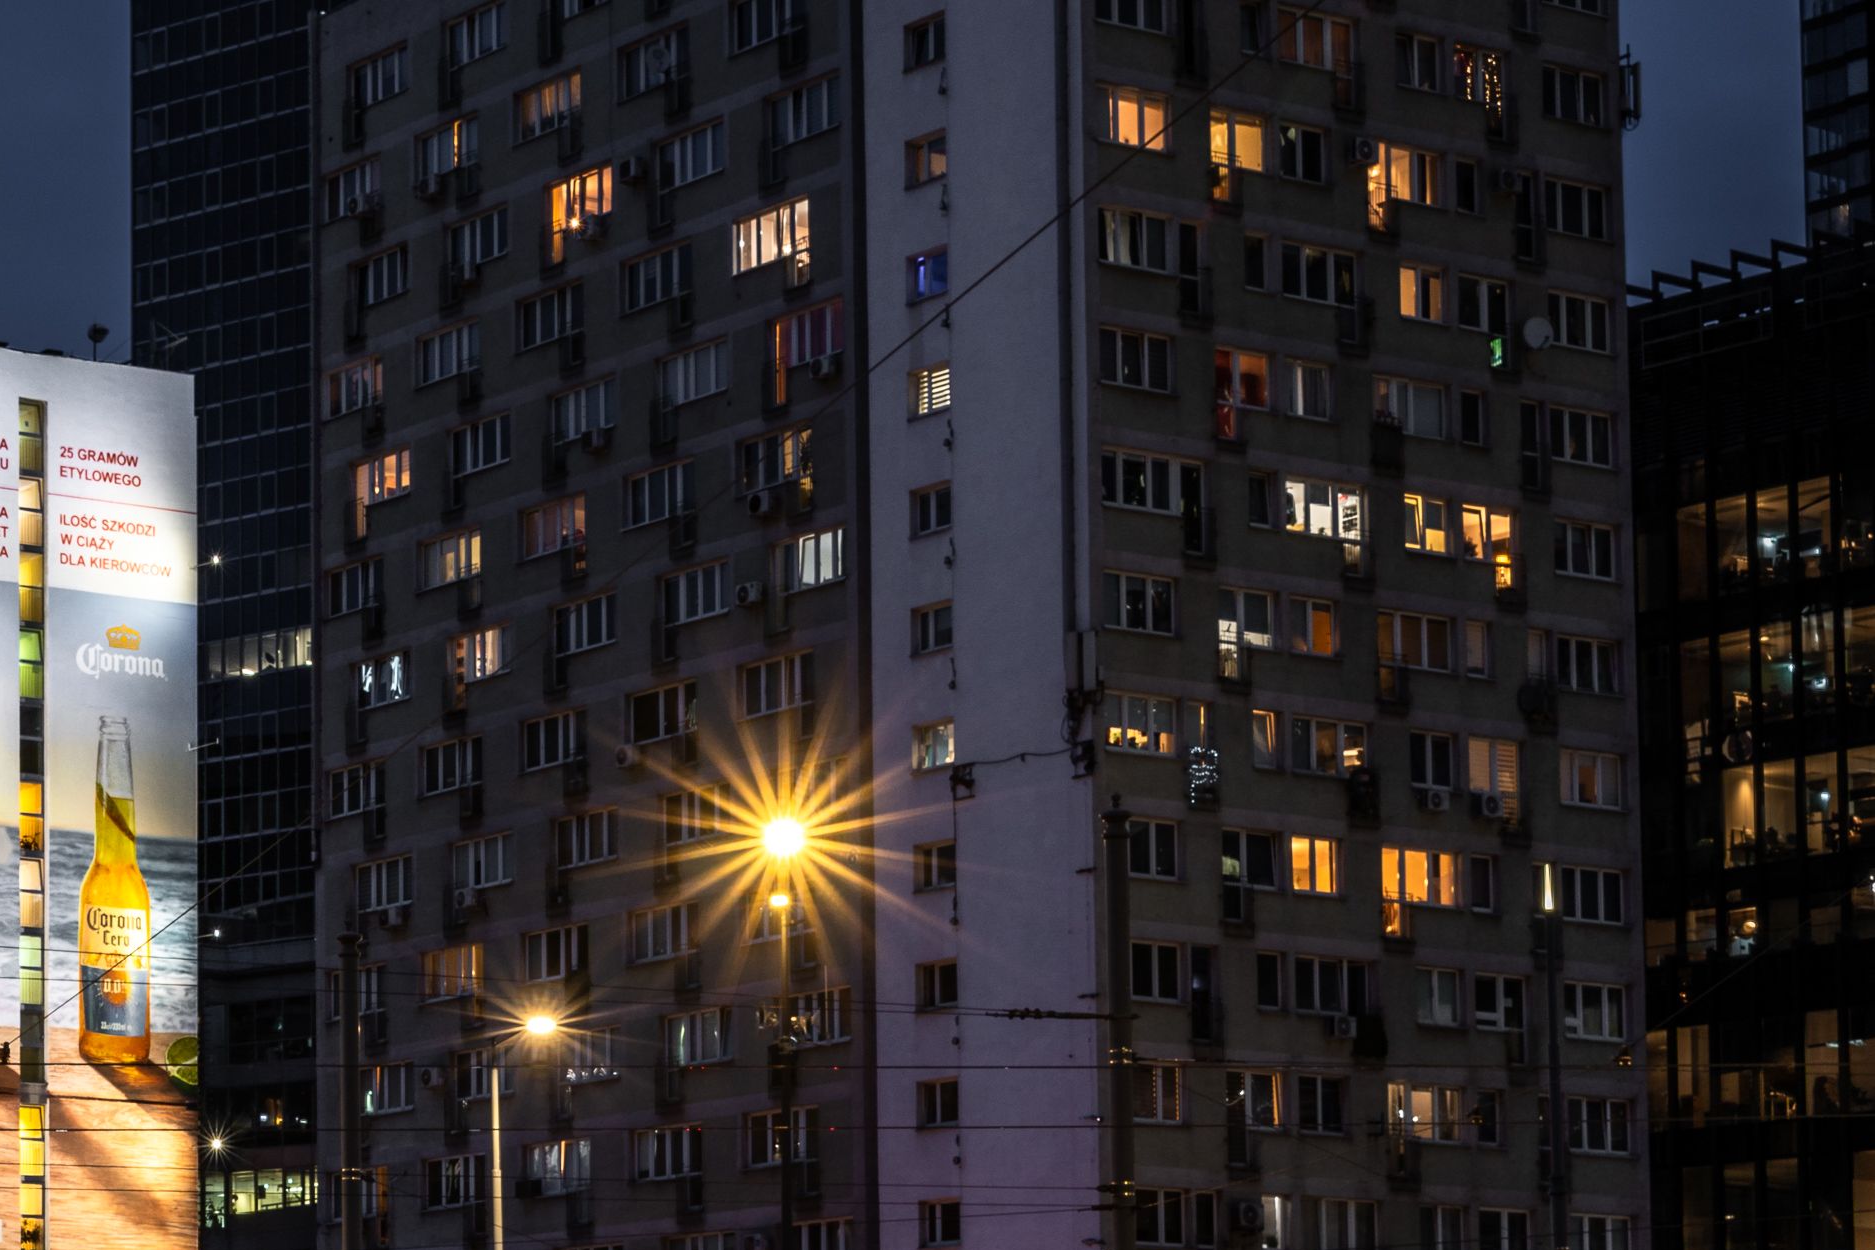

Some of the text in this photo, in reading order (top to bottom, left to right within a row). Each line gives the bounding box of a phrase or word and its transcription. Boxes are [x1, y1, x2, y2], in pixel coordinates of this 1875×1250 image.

[59, 446, 74, 459] 25
[77, 448, 139, 468] GRAMÓW
[59, 465, 142, 488] ETYLOWEGO
[59, 513, 97, 529] ILOŚĆ
[101, 518, 156, 537] SZKODZI
[60, 533, 73, 545] W
[76, 535, 115, 552] CIĄŻY
[59, 552, 86, 567] DLA
[89, 556, 172, 577] KIEROWCÓW
[75, 642, 166, 680] Corona
[86, 906, 142, 934] Corona
